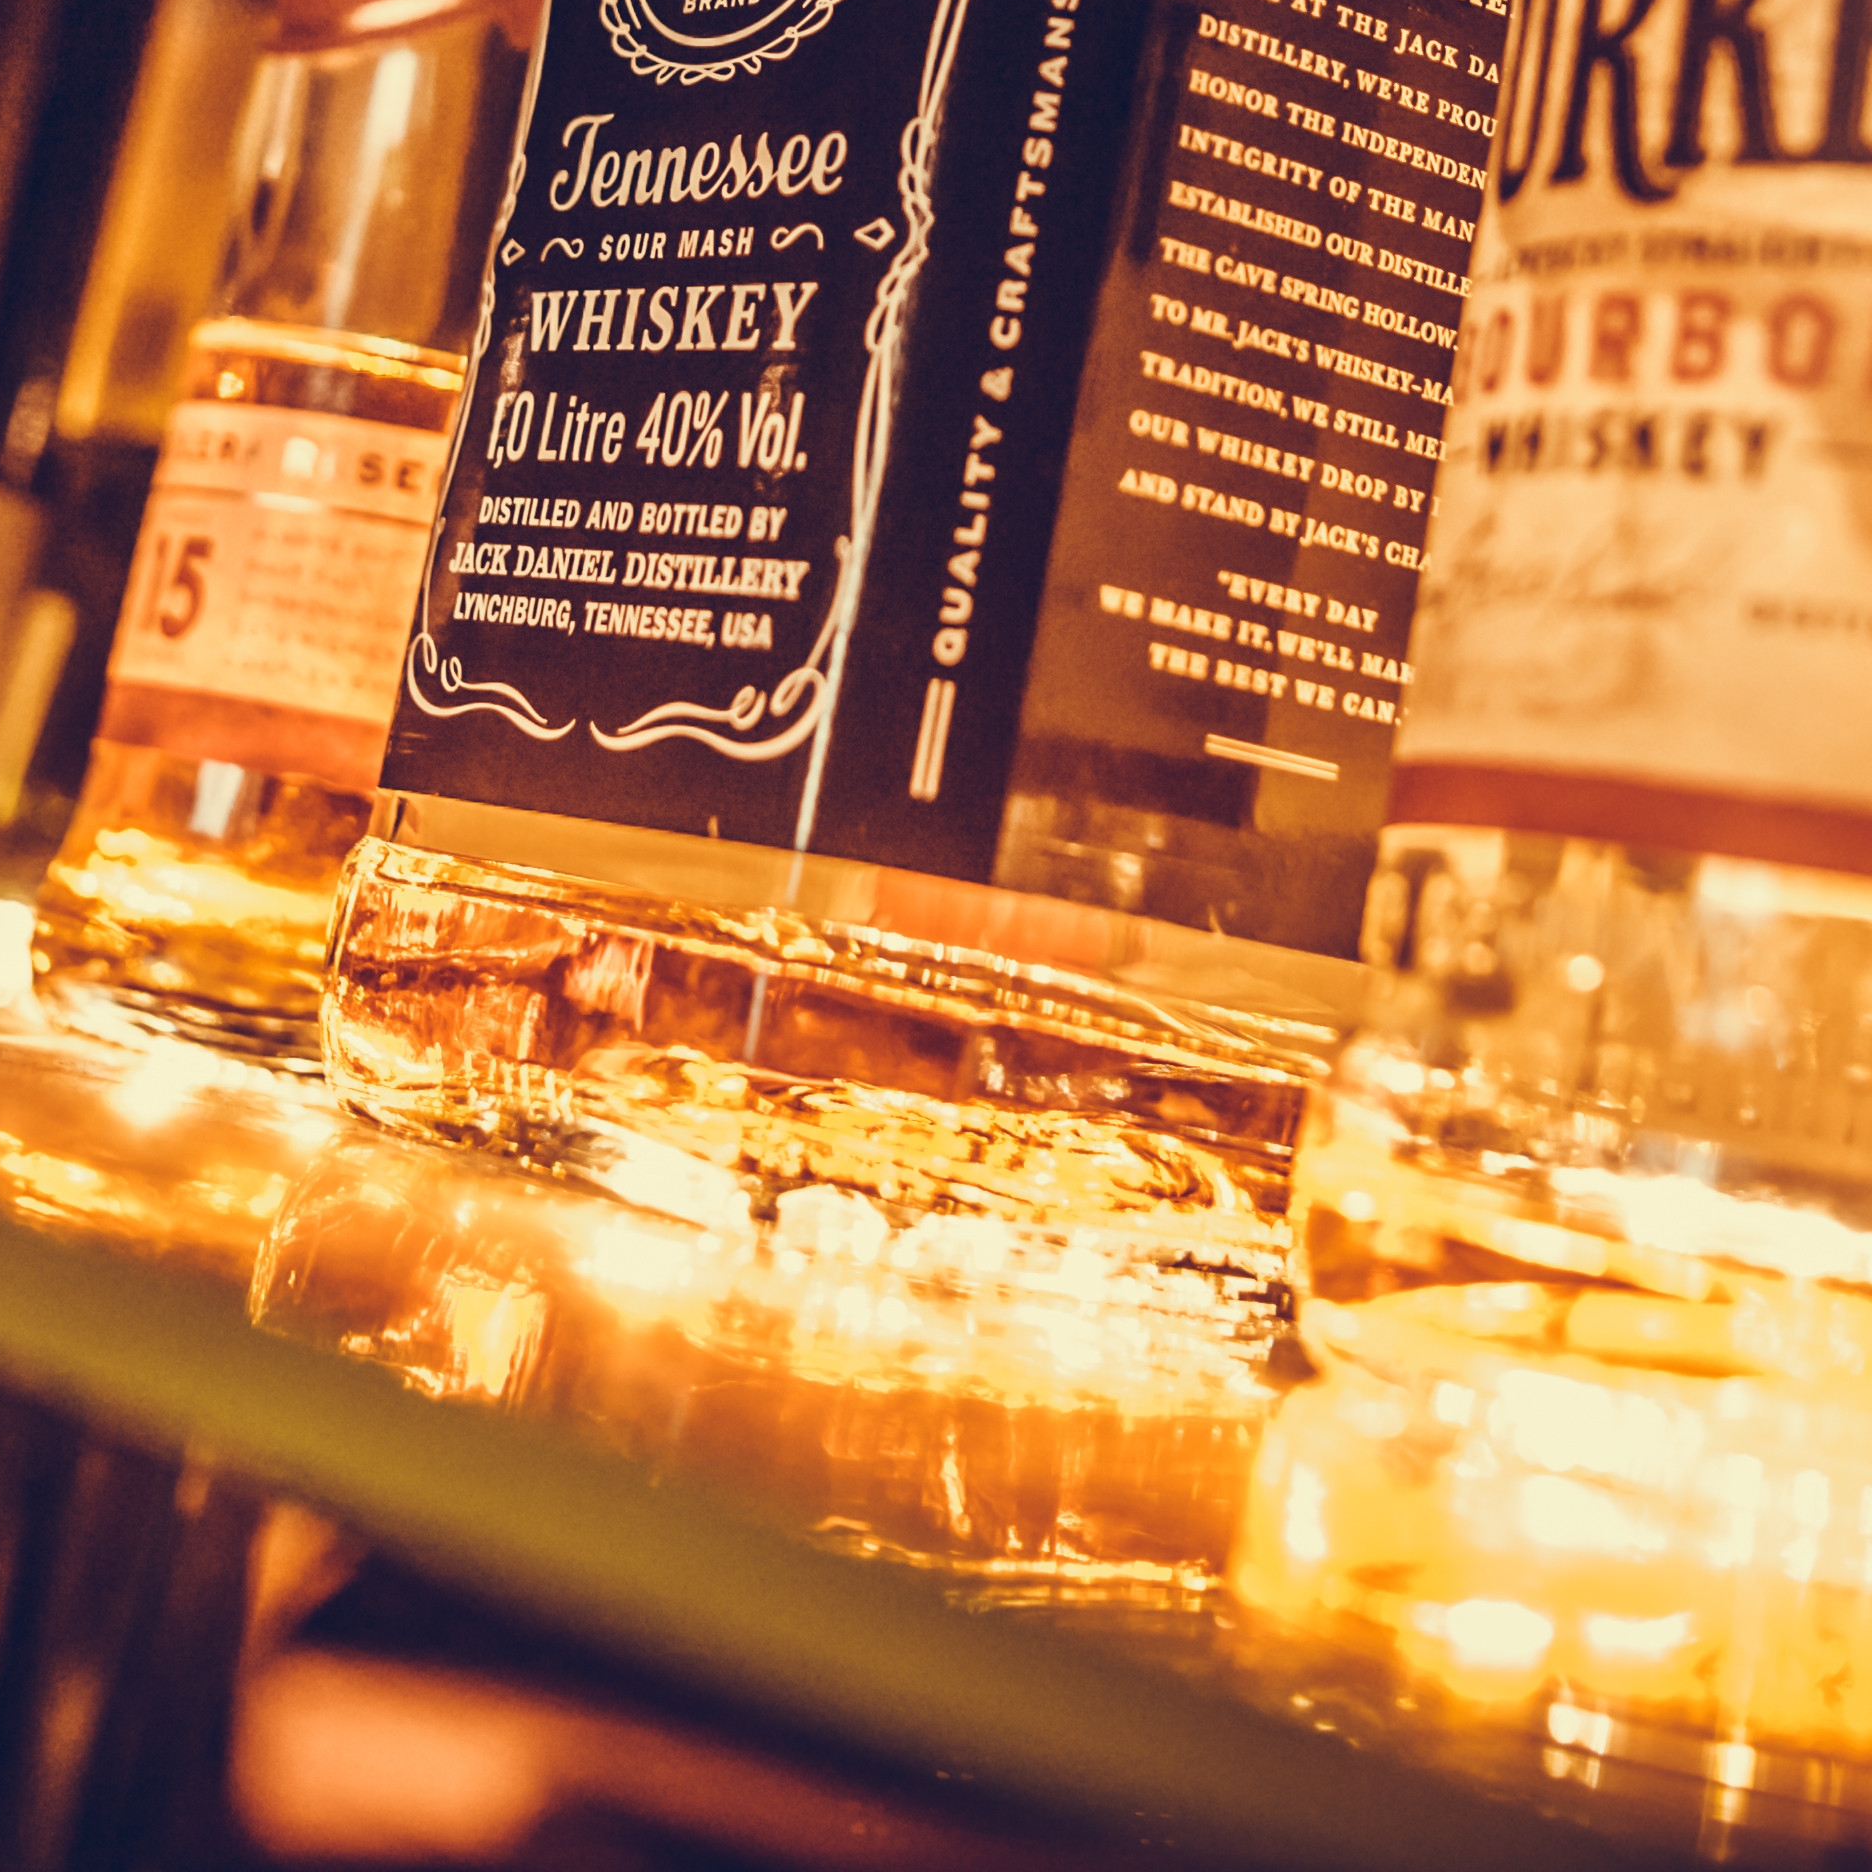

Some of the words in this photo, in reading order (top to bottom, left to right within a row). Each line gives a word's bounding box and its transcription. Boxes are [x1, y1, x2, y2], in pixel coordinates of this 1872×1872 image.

[1198, 13, 1350, 89] DISTILLERY,
[1356, 69, 1430, 114] WE'RE
[1435, 98, 1499, 138] PROU
[1337, 5, 1389, 42] THE
[1393, 29, 1459, 69] JACK
[1467, 54, 1500, 84] DA
[550, 114, 848, 211] Tennessee
[1188, 69, 1279, 119] HONOR
[1286, 102, 1336, 137] THE
[1341, 122, 1488, 190] INDEPENDEN
[1179, 124, 1323, 191] INTEGRITY
[1329, 176, 1362, 203] OF
[1367, 188, 1417, 223] THE
[1421, 207, 1476, 242] MAN
[599, 232, 667, 262] SOUR
[678, 226, 755, 258] MASH
[1168, 180, 1323, 249] ESTABLISHED
[1325, 232, 1374, 268] OUR
[1377, 248, 1473, 298] DISTILLE
[528, 281, 818, 352] WHISKEY
[1150, 293, 1188, 325] TO
[1190, 306, 1233, 340] MR.
[1232, 320, 1310, 363] JACK'S
[1160, 236, 1212, 274] THE
[1214, 255, 1277, 294] CAVE
[1279, 275, 1360, 319] SPRING
[1362, 301, 1459, 351] HOLLOW.
[537, 392, 626, 464] Litre
[636, 390, 729, 469] 40%
[737, 391, 808, 472] Vol.
[1140, 350, 1288, 419] TRADITION,
[1292, 395, 1329, 428] WE
[1333, 409, 1400, 448] STILL
[1129, 409, 1189, 448] OUR
[1197, 427, 1315, 482] WHISKEY
[1320, 462, 1388, 502] DROP
[1393, 484, 1426, 513] BY
[479, 496, 581, 528] DISTILLED
[585, 500, 634, 532] AND
[639, 502, 743, 539] BOTTLED
[747, 506, 788, 542] BY
[931, 414, 1004, 667] QUALITY
[980, 366, 1014, 402] &
[1118, 468, 1178, 505] AND
[1181, 483, 1265, 528] STAND
[1268, 507, 1301, 538] BY
[1300, 518, 1379, 559] JACK'S
[449, 542, 511, 576] JACK
[513, 545, 617, 584] DANIEL
[622, 552, 811, 601] DISTILLERY
[454, 592, 576, 636] LYNCHBURG,
[584, 601, 716, 649] TENNESSEE,
[721, 612, 773, 650] USA
[1099, 584, 1145, 619] WE
[1149, 597, 1232, 641] MAKE
[1277, 630, 1354, 671] WE'LL
[1326, 599, 1379, 633] DAY
[1149, 642, 1209, 680] THE
[1215, 659, 1288, 698] BEST
[1295, 679, 1336, 710] WE
